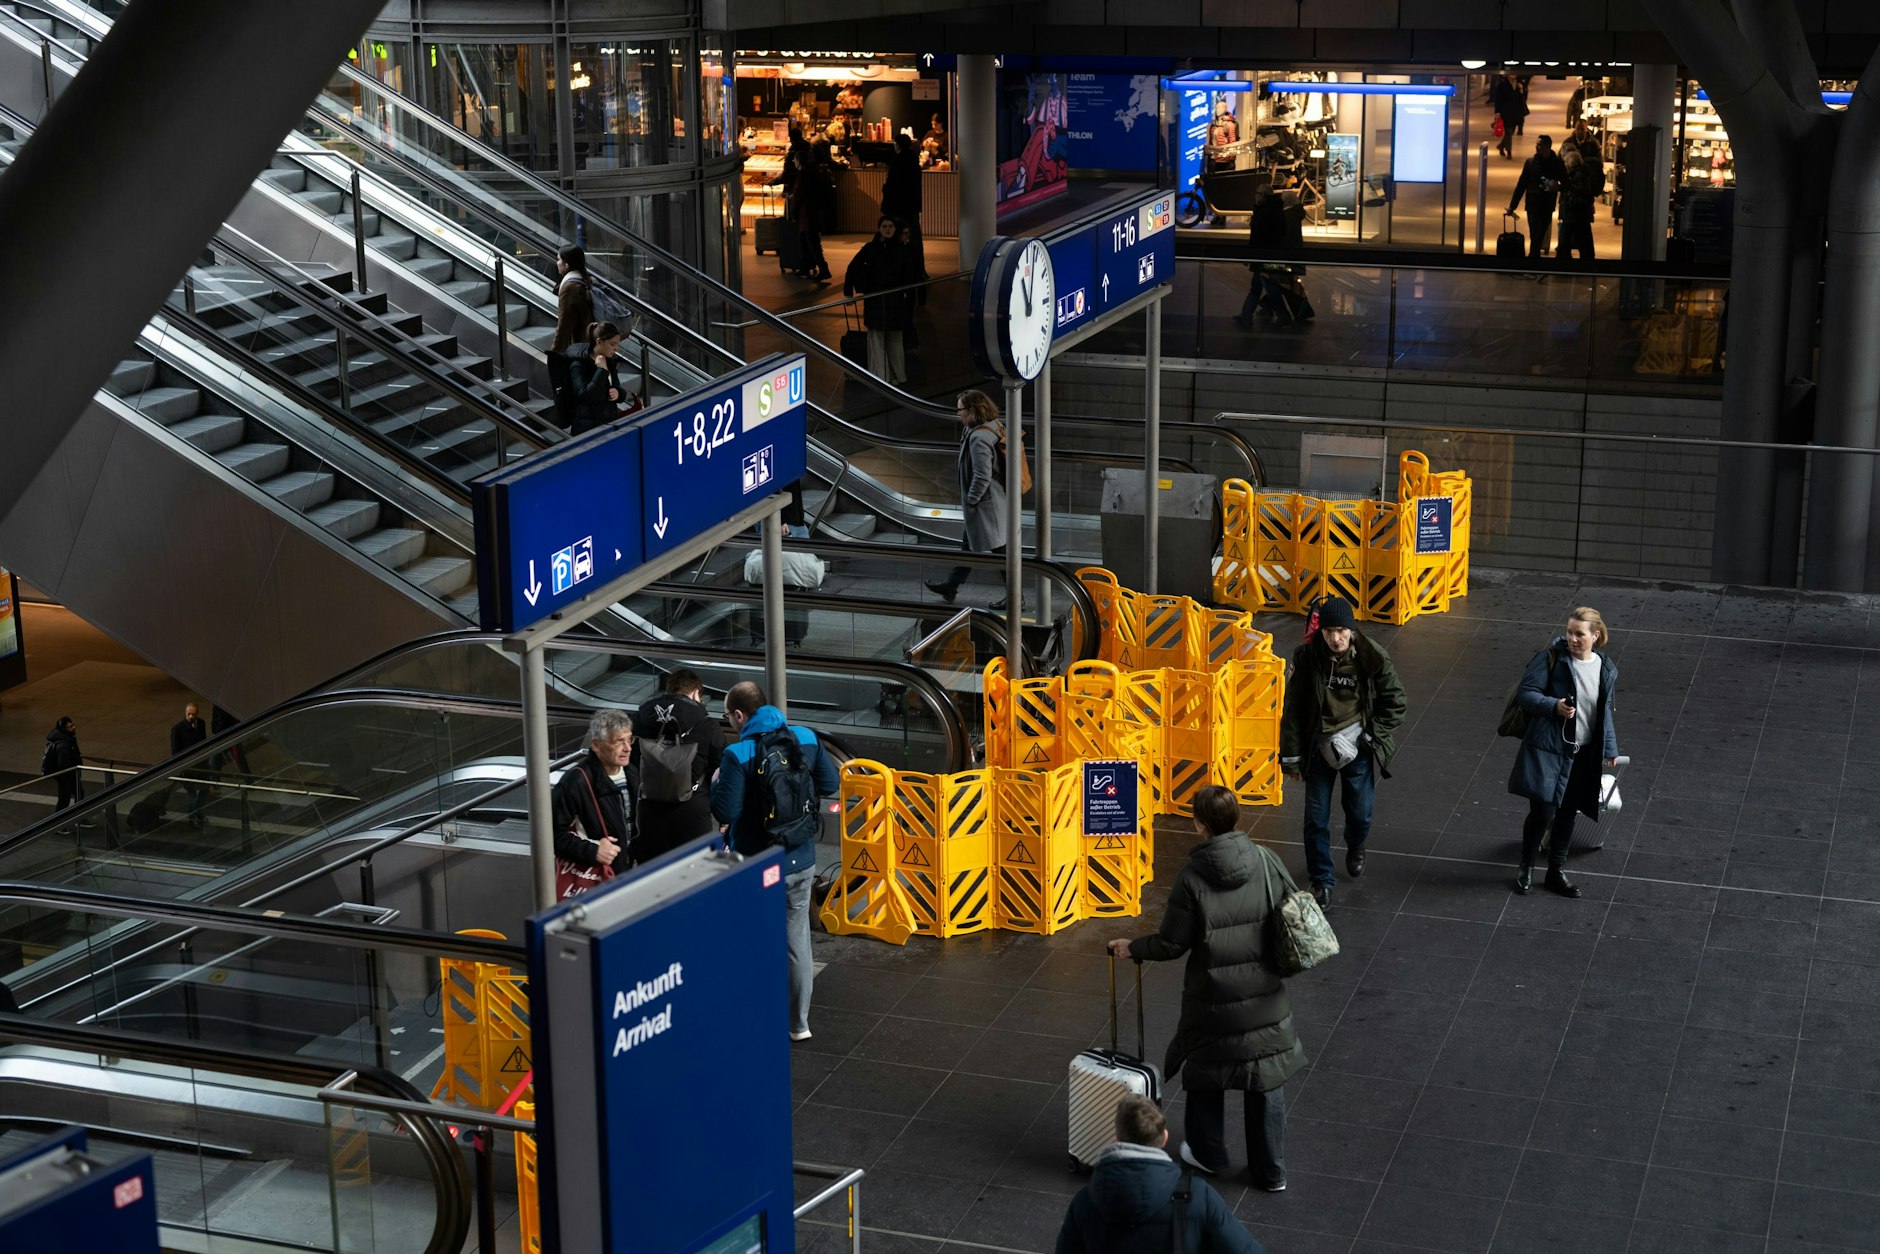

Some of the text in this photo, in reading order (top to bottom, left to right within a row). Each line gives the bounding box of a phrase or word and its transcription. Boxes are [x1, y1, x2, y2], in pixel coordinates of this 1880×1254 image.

[1068, 131, 1093, 139] THLON
[1112, 215, 1135, 253] 11-16
[1147, 207, 1154, 232] S
[760, 383, 772, 417] S
[673, 398, 735, 465] 1-8,22
[613, 962, 684, 1019] Ankunft
[612, 1003, 672, 1057] Arrival
